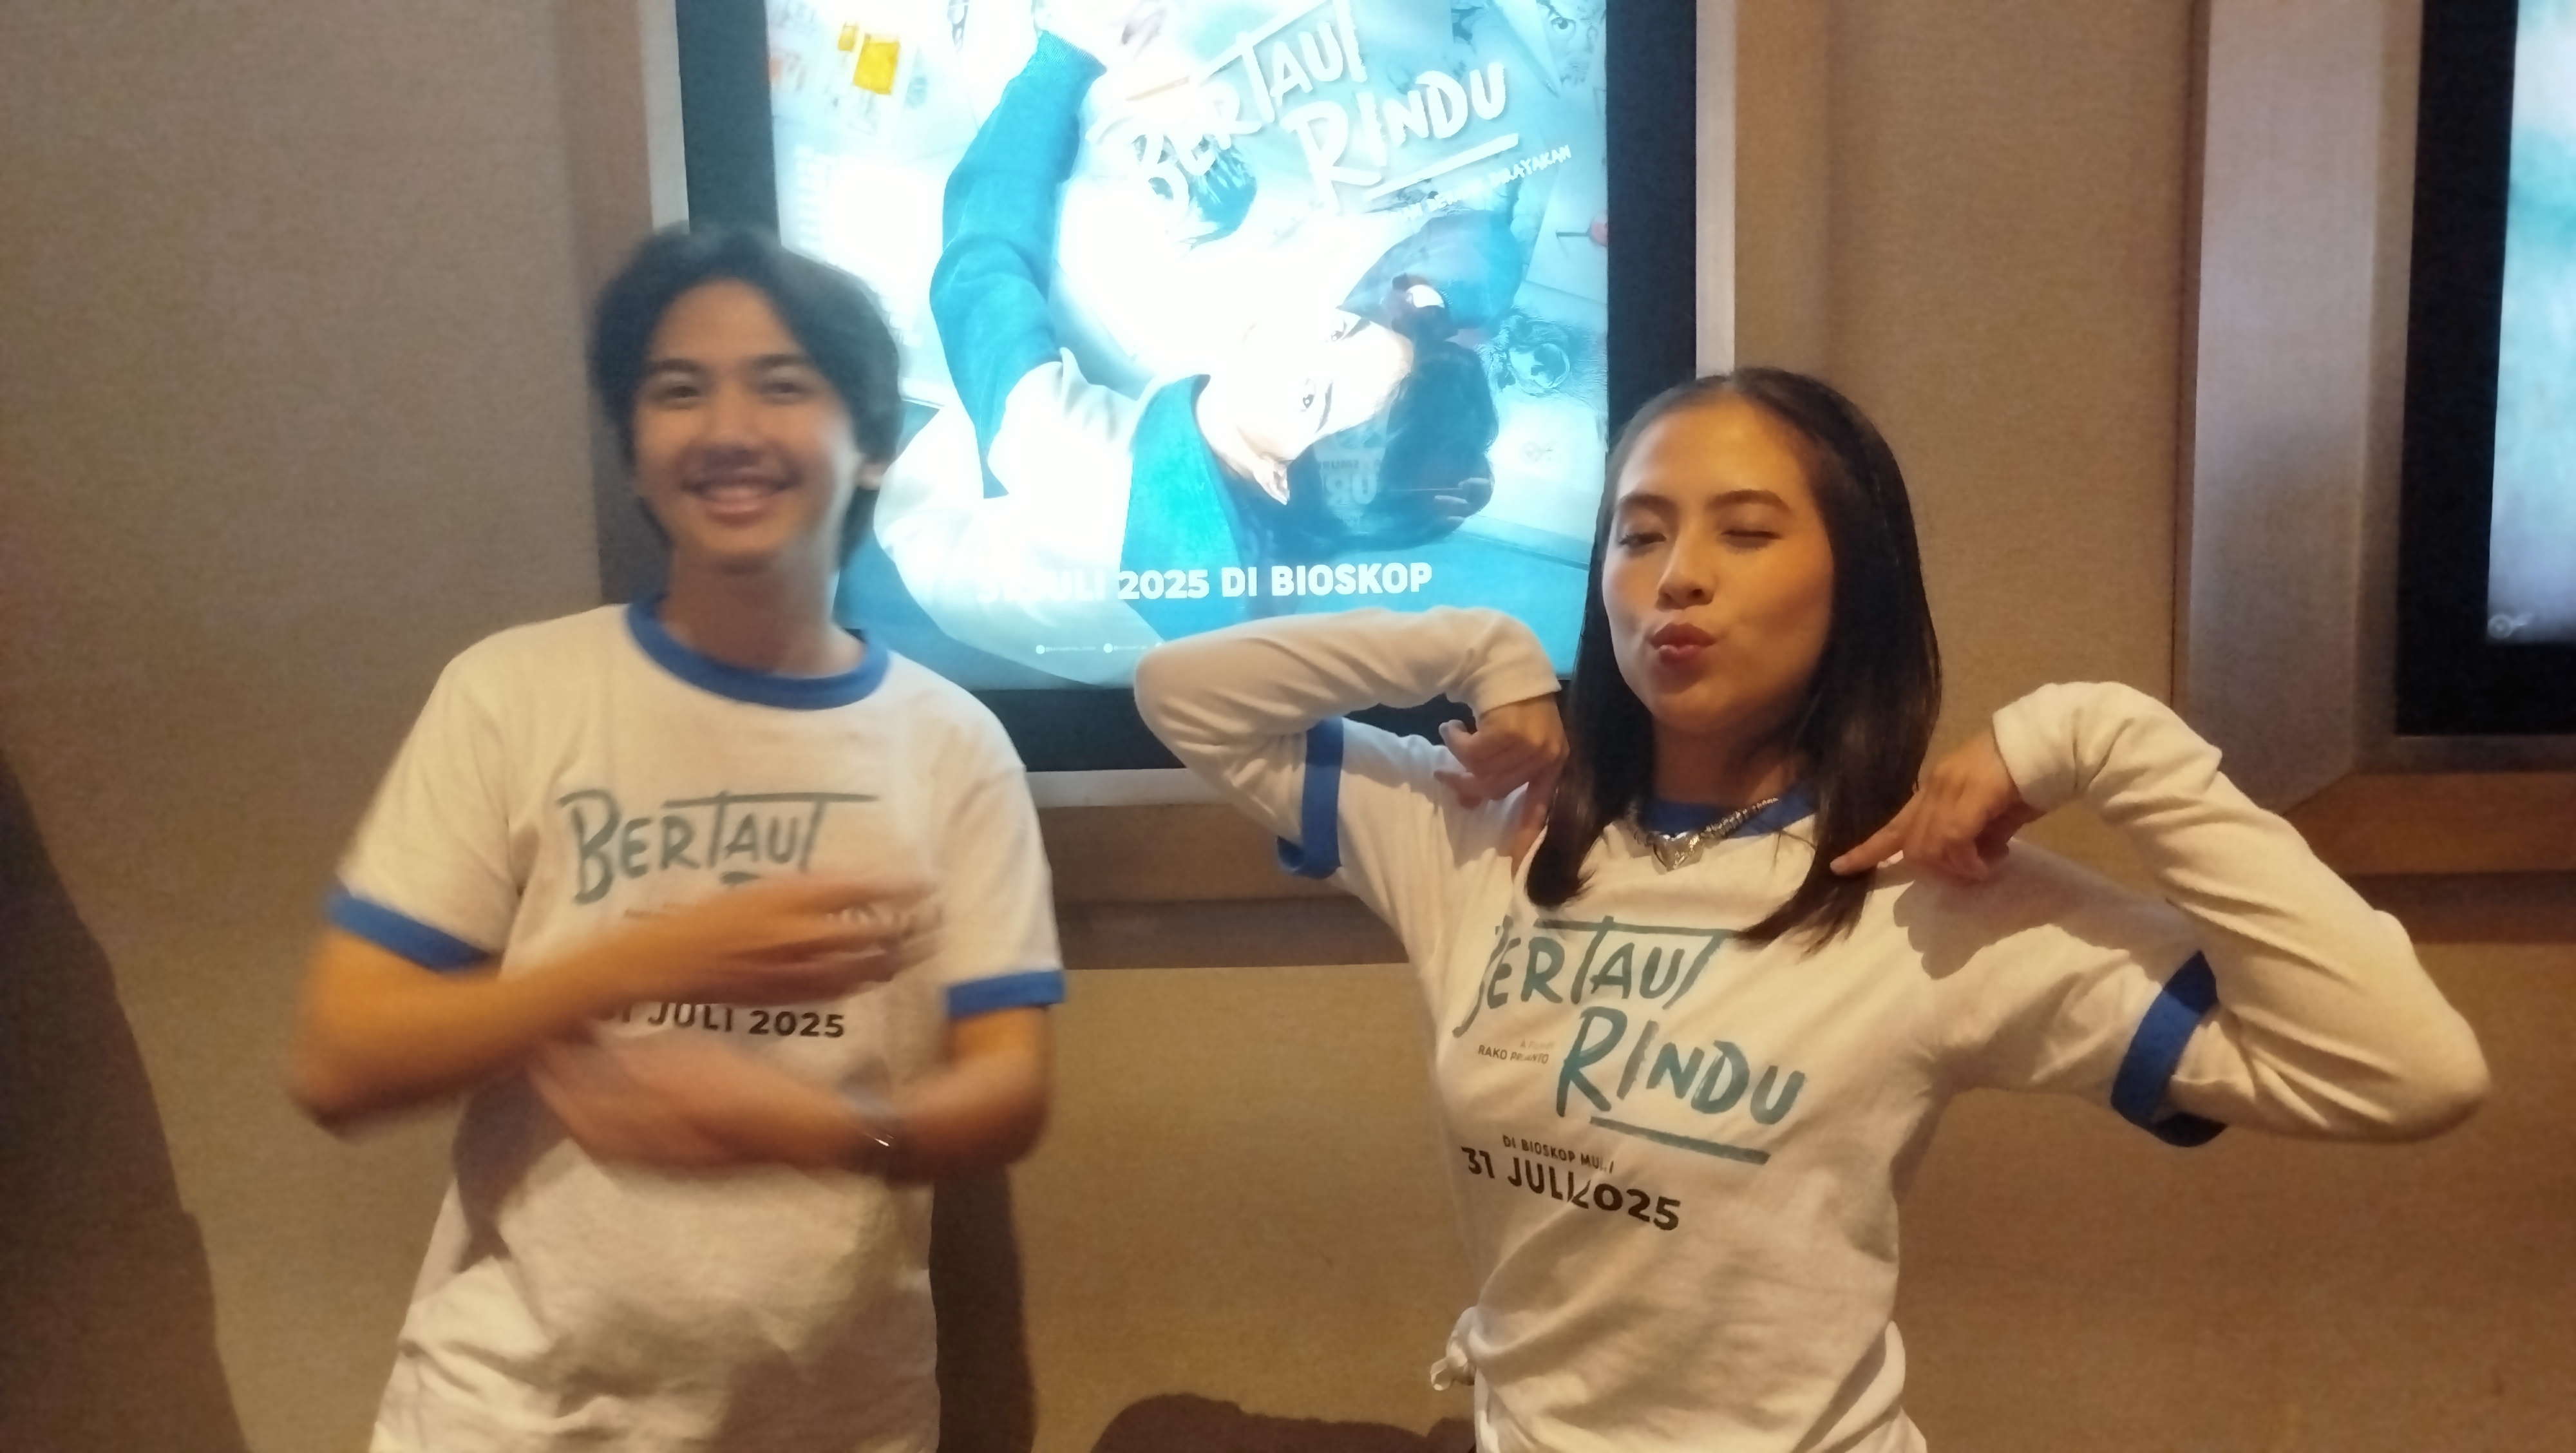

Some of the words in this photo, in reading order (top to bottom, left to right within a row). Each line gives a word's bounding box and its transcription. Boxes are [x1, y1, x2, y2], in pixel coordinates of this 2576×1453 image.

[1284, 62, 1507, 215] RINDU
[1025, 568, 1106, 602] ULI
[1118, 569, 1209, 600] 2025
[1221, 567, 1257, 598] DI
[1271, 562, 1433, 596] BIOSKOP
[556, 790, 881, 905] BERTAUT
[647, 1001, 733, 1031] JULI
[748, 1010, 845, 1038] 2025
[1477, 1044, 1508, 1060] RAKO
[1556, 1006, 1808, 1125] RINDU
[1502, 1134, 1516, 1149] DI
[1521, 1138, 1576, 1163] BIOSKOP
[1461, 1146, 1495, 1179] 31
[1507, 1157, 1575, 1203] JULI
